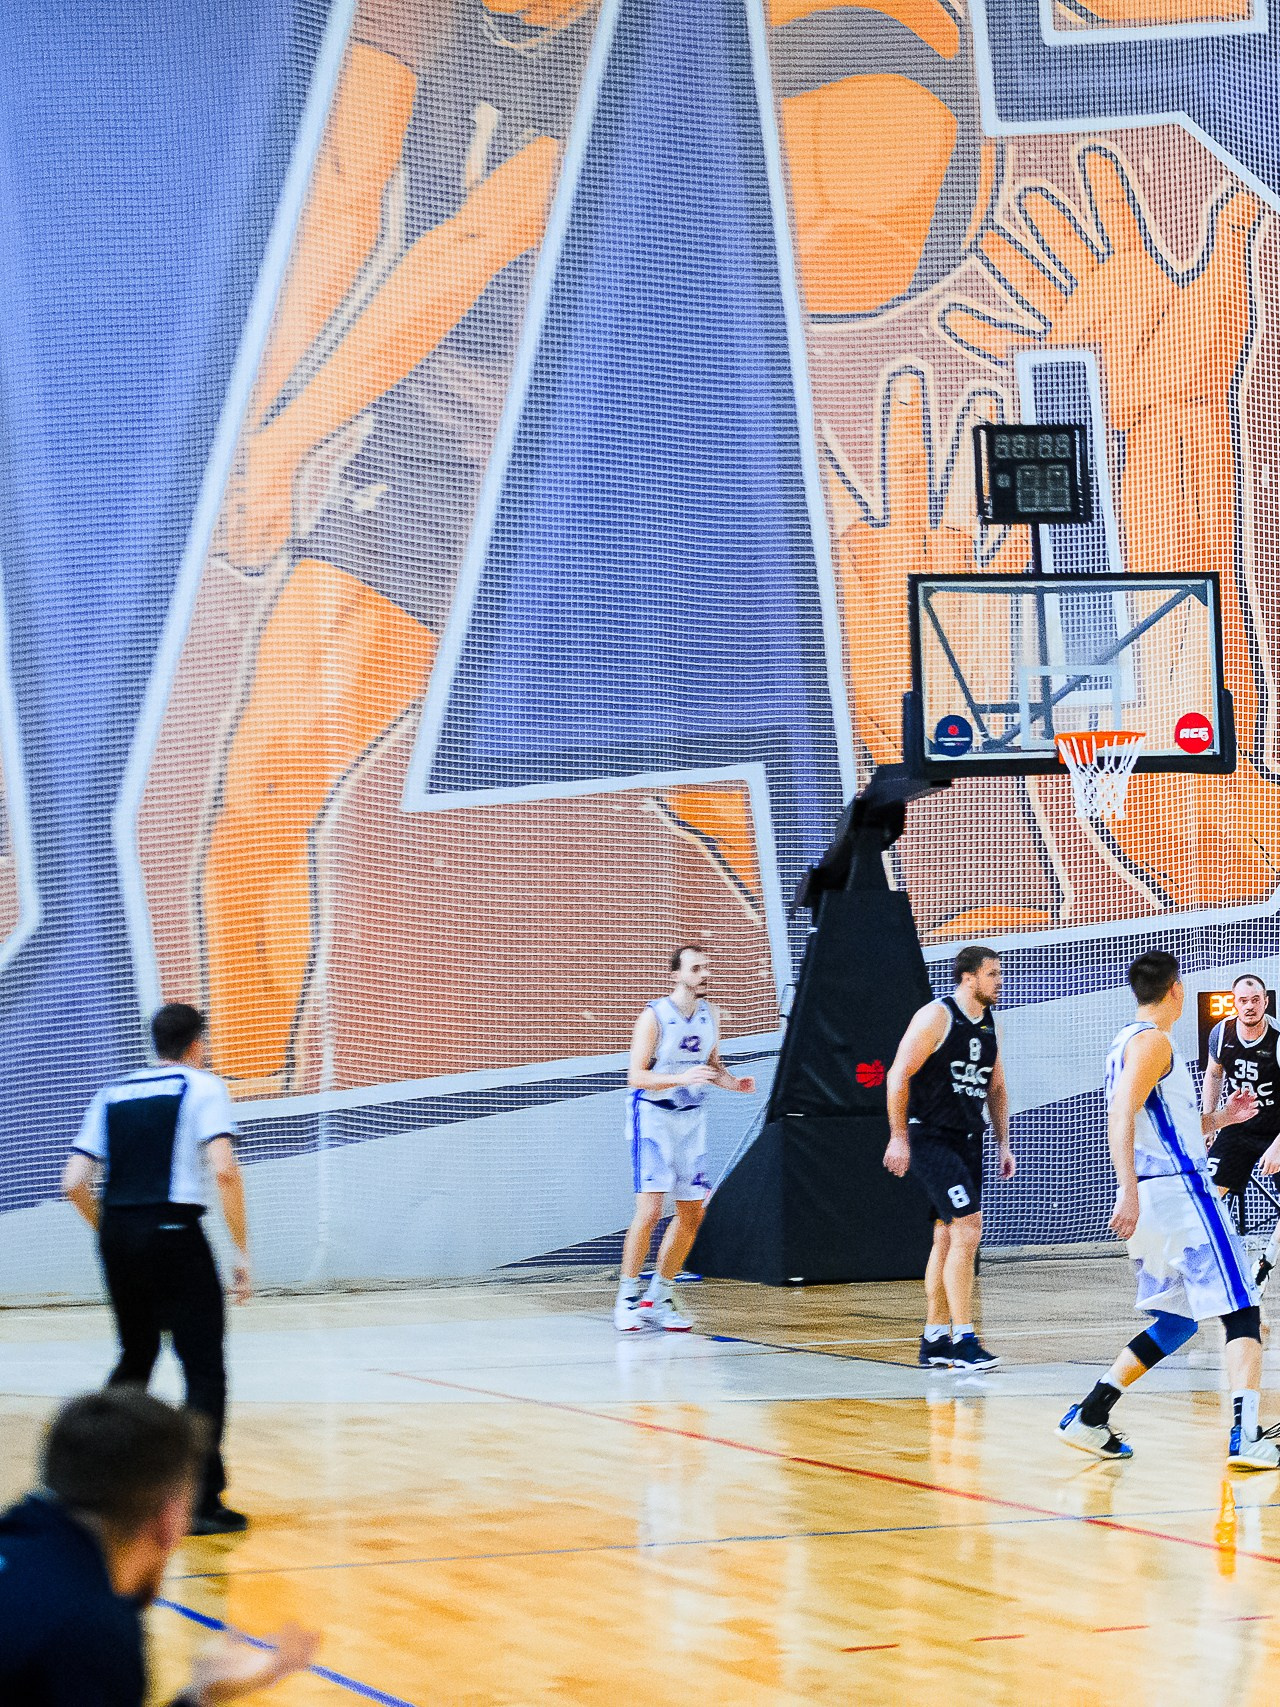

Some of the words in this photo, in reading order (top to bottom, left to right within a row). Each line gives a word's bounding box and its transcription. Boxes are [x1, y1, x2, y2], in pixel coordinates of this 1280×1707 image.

[679, 1035, 701, 1053] 42
[969, 1037, 982, 1061] 8
[950, 1060, 994, 1085] СДС
[1233, 1058, 1259, 1081] 35
[947, 1184, 971, 1209] 8
